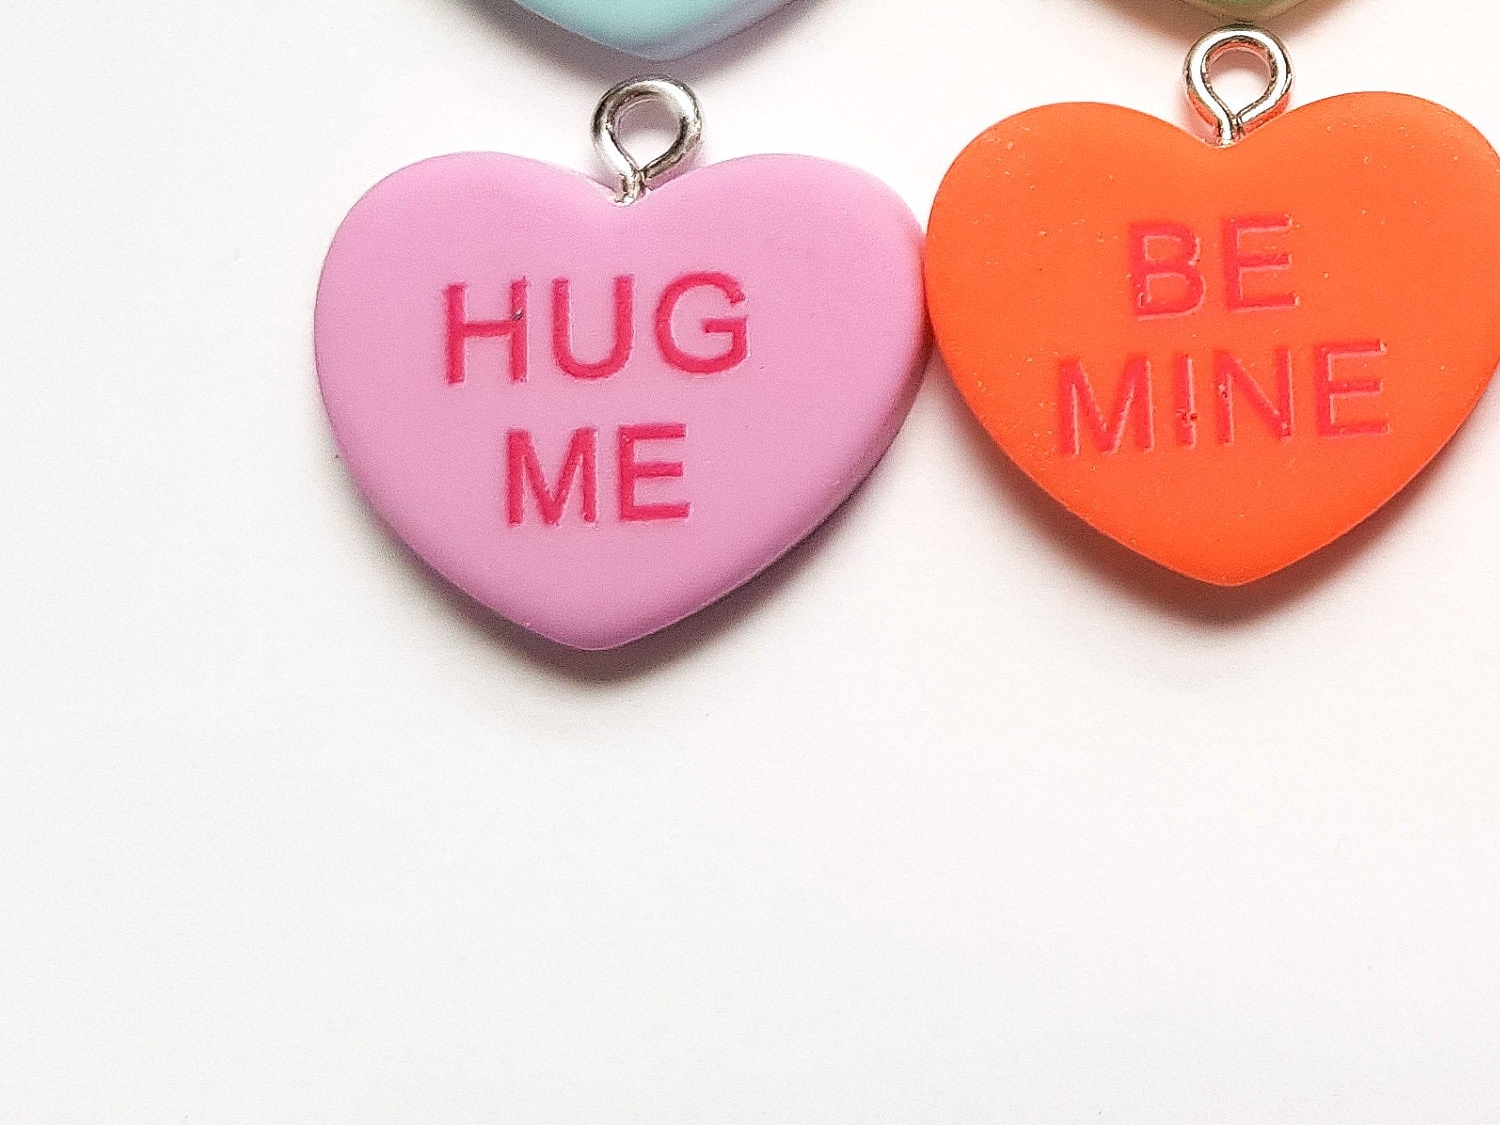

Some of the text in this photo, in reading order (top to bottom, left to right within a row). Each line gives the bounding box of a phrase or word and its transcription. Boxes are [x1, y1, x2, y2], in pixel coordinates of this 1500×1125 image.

[1124, 214, 1303, 324] BE
[441, 269, 749, 387] HUG
[1055, 337, 1394, 460] MINE
[504, 422, 691, 527] ME
